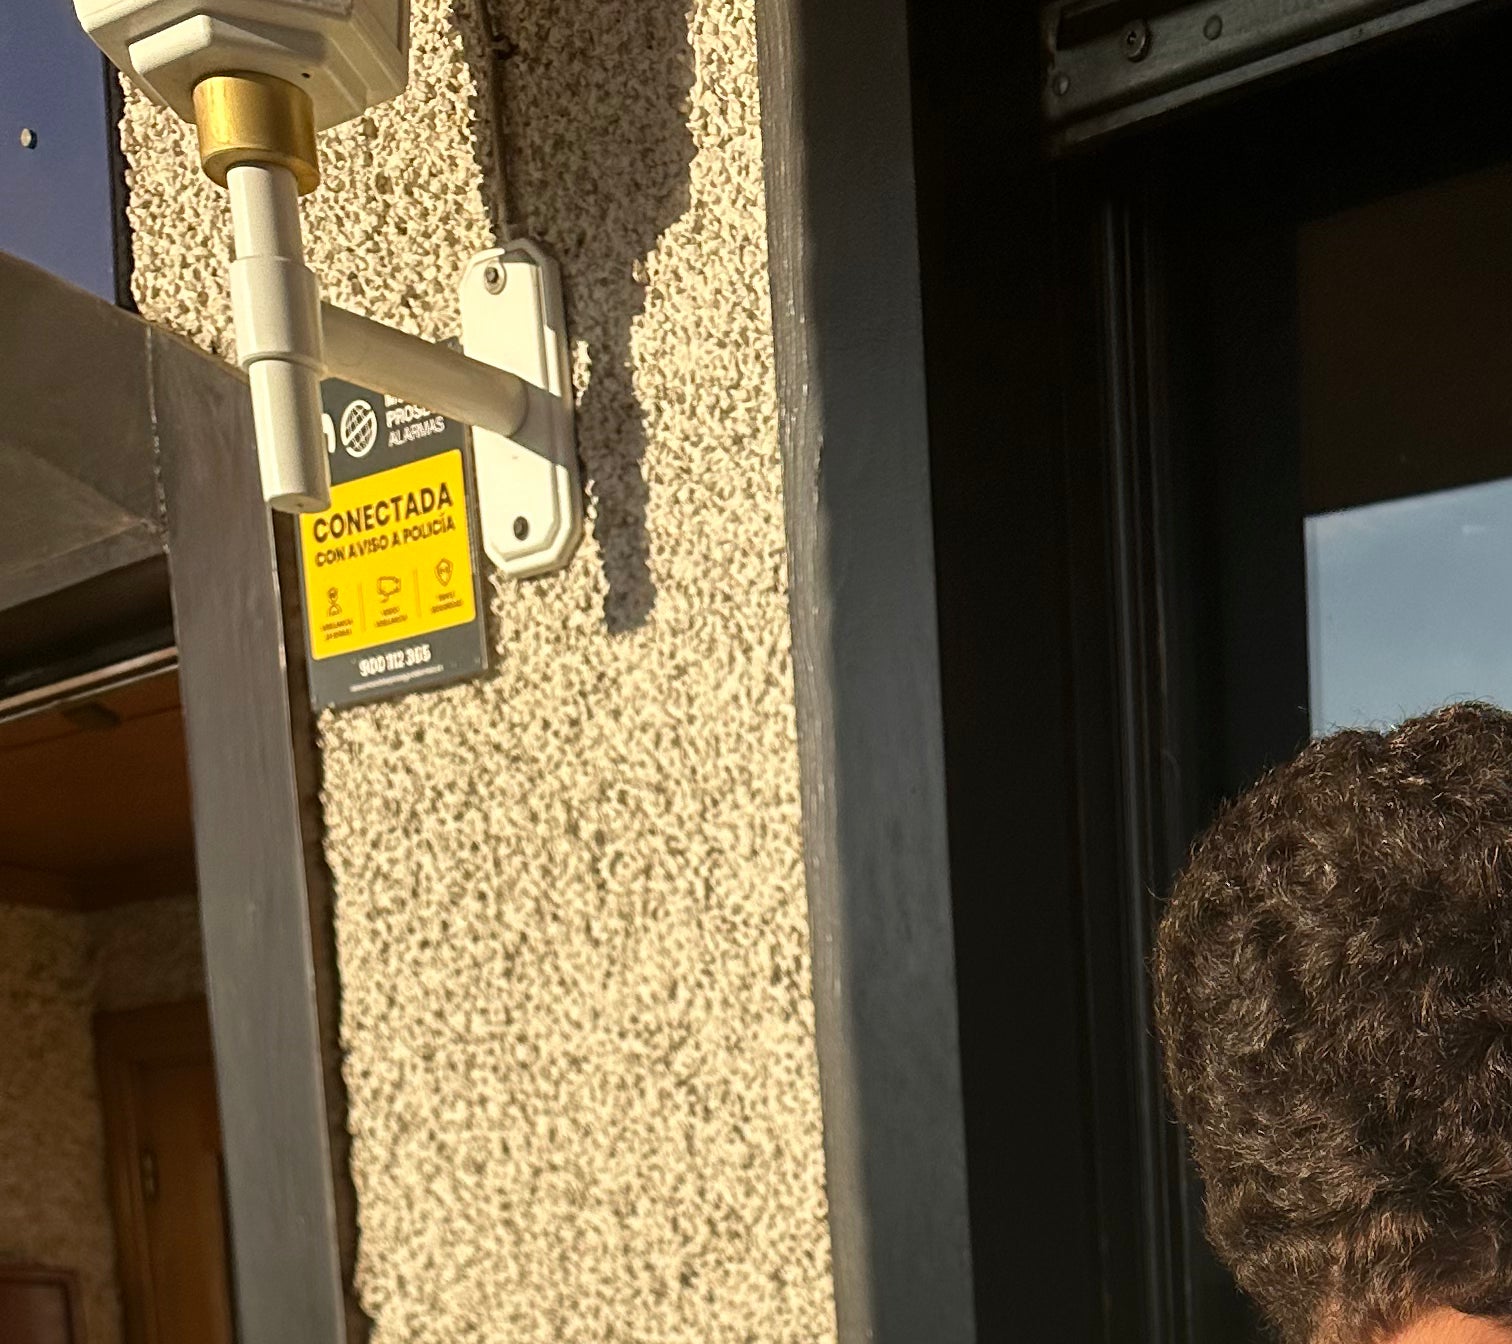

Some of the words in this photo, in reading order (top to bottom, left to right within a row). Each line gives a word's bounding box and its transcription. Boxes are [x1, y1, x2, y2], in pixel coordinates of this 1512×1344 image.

[388, 415, 446, 448] ALARMAS
[313, 482, 454, 544] CONECTADA
[315, 545, 346, 568] CON
[347, 534, 389, 560] AVISO
[392, 531, 401, 548] A
[403, 512, 456, 545] POLICÍA
